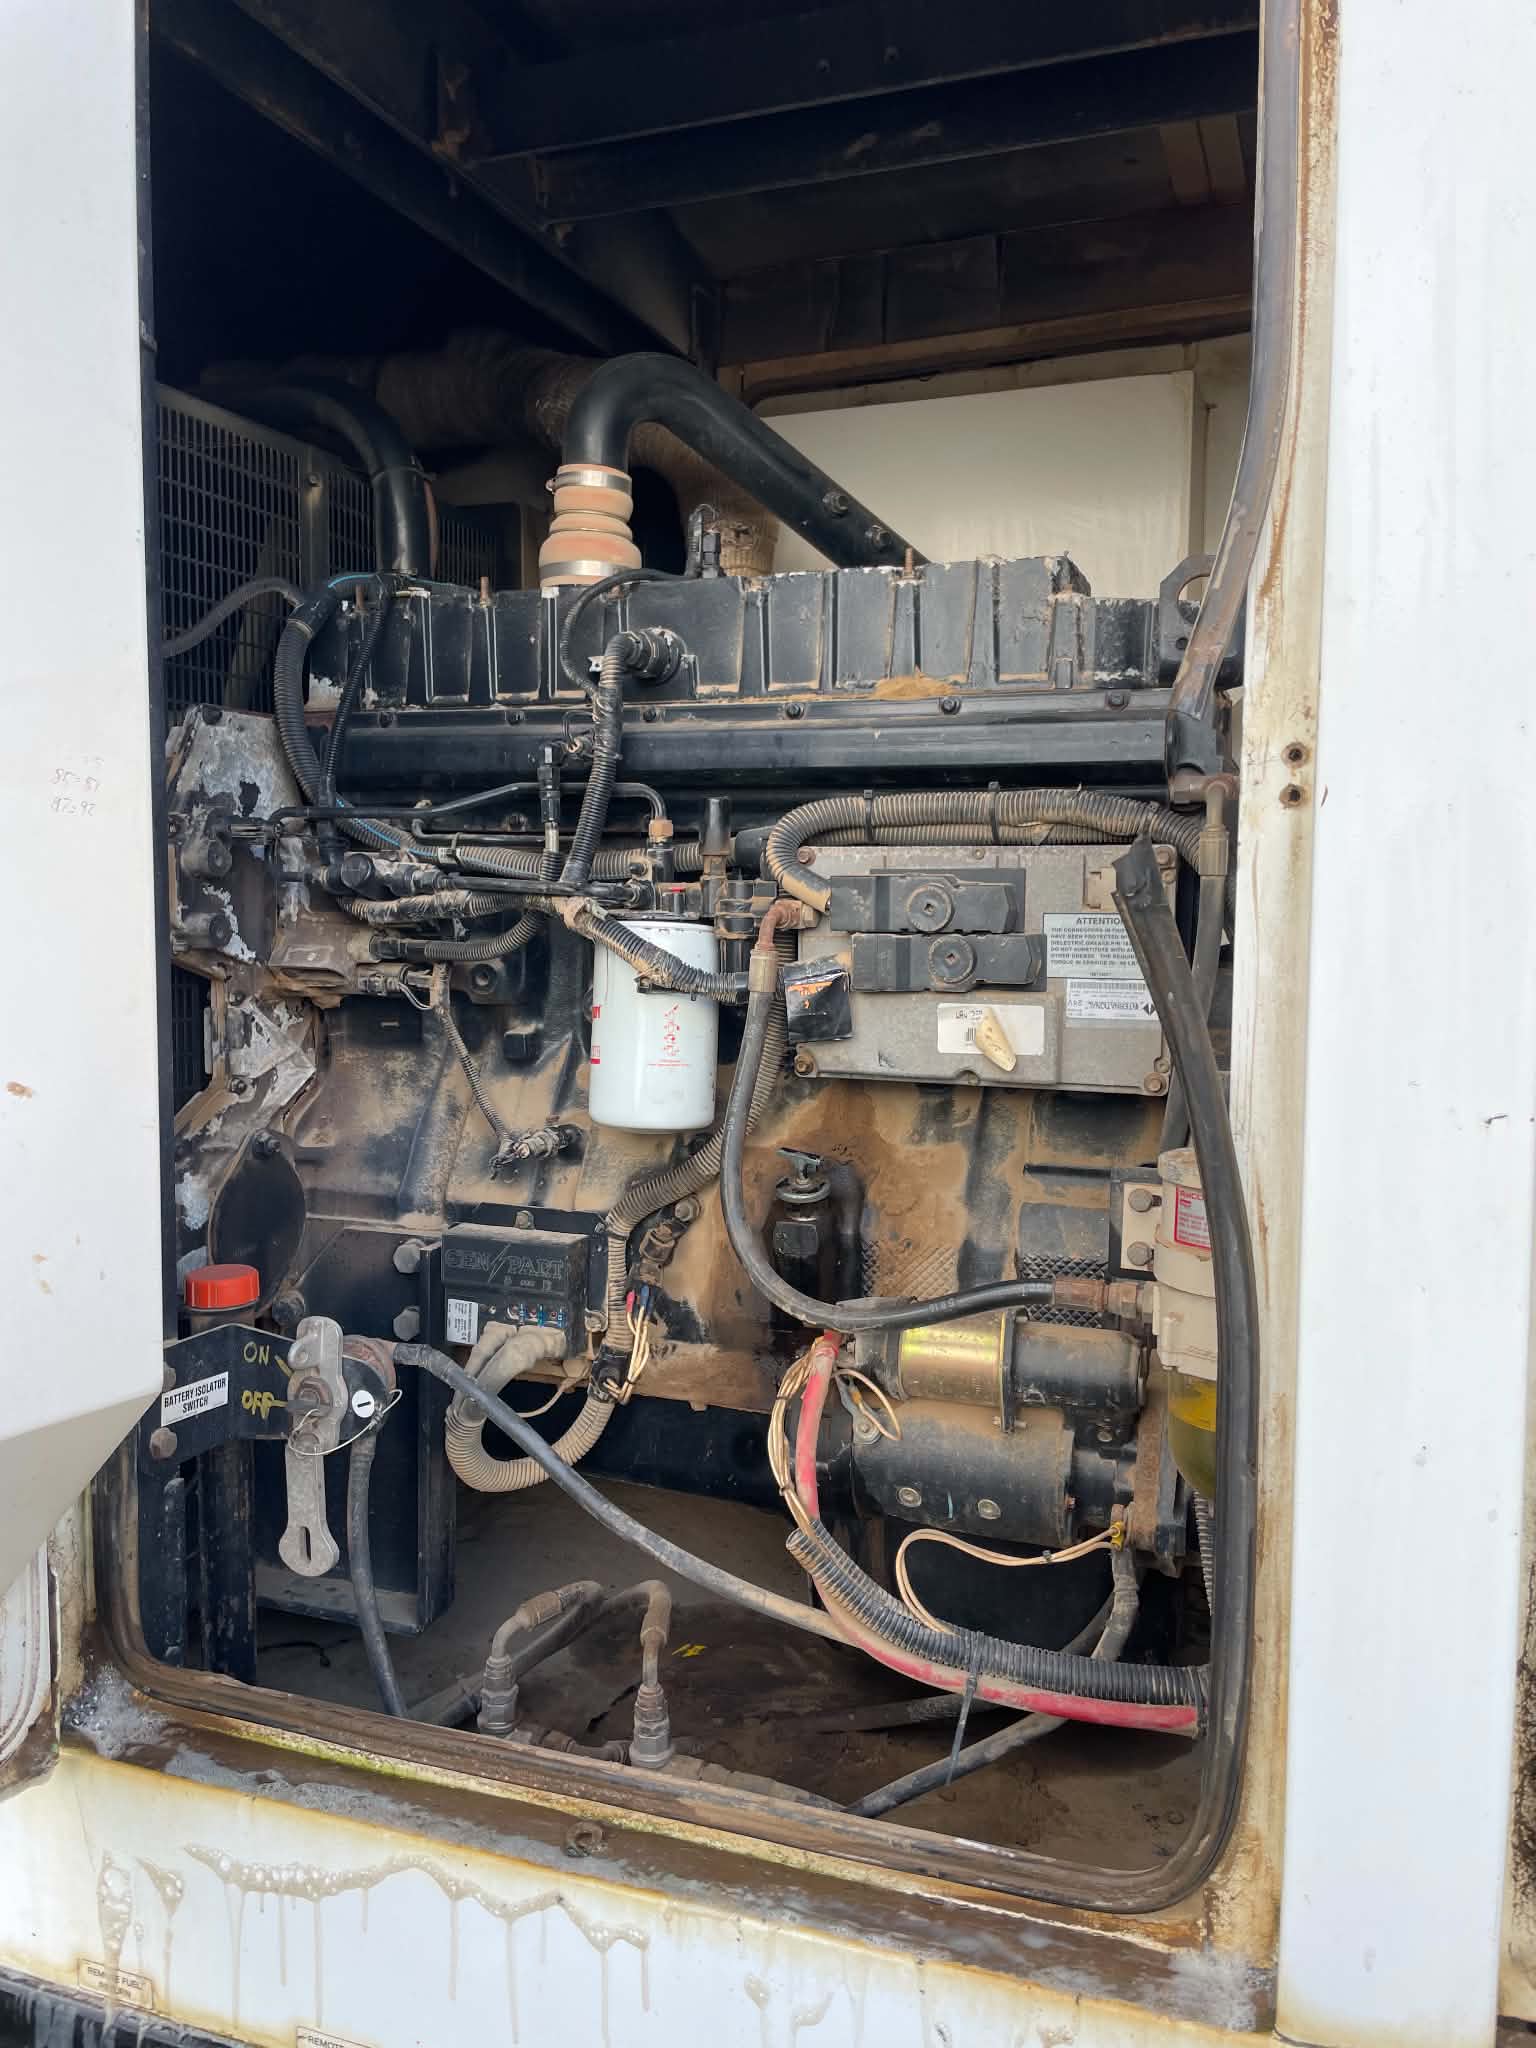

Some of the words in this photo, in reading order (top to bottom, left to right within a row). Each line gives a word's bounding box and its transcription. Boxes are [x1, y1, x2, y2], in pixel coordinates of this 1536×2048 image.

[1075, 917, 1121, 925] ATTENTIO
[243, 1340, 270, 1366] ON
[164, 1389, 194, 1409] BATTERY
[195, 1377, 226, 1397] ISOLATOR
[182, 1396, 209, 1414] SWITCH
[241, 1389, 275, 1420] OFF
